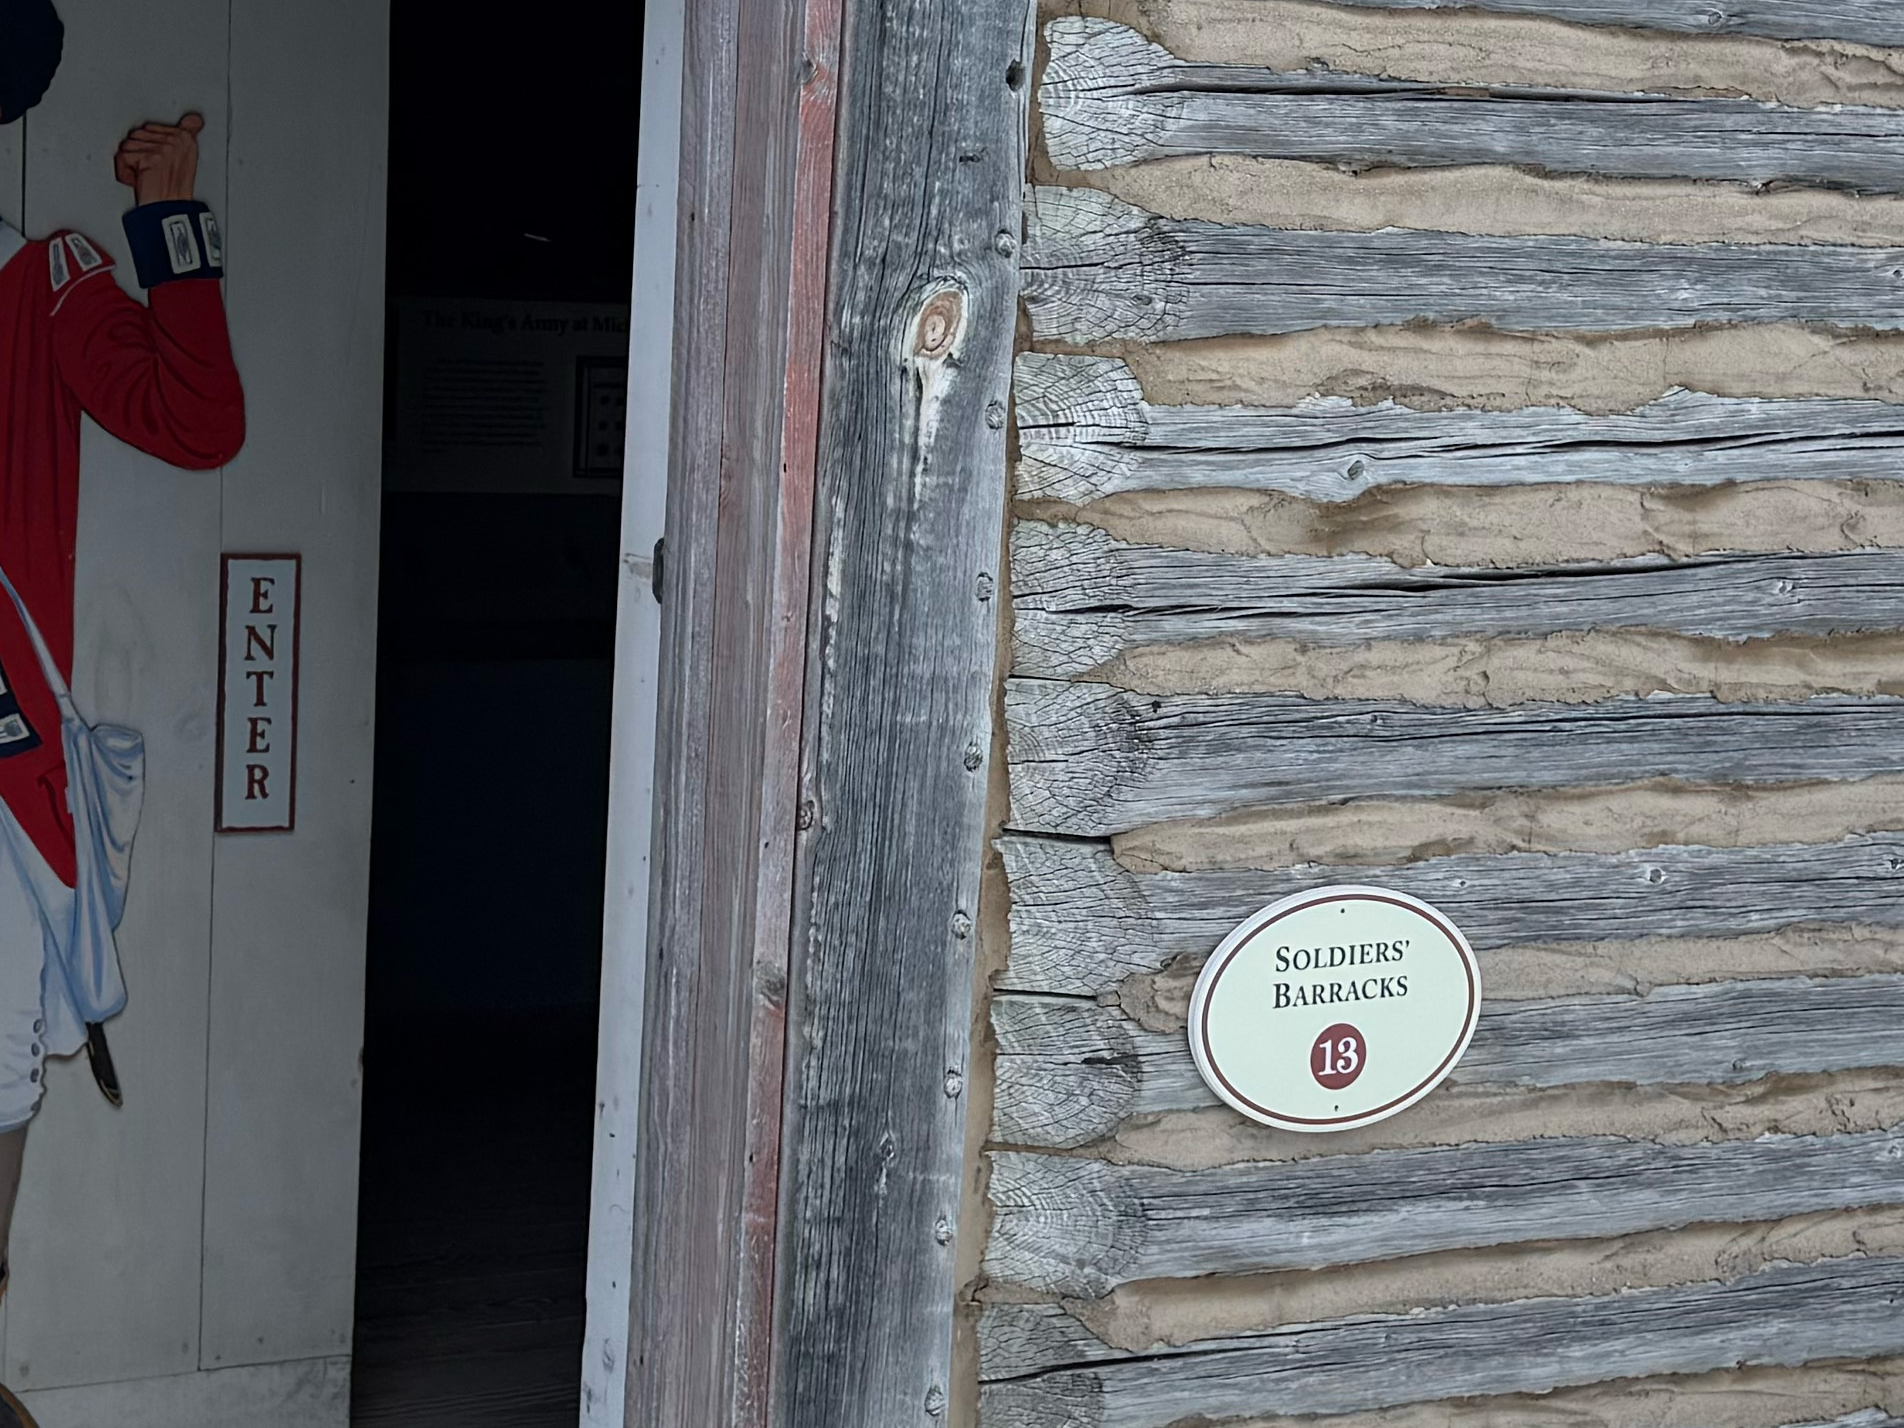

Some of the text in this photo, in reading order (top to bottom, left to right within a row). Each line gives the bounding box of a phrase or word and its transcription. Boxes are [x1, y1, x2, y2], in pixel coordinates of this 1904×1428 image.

[422, 310, 456, 328] The
[461, 310, 516, 335] King's
[522, 314, 568, 336] Army
[244, 577, 277, 800] ENTER
[1276, 940, 1410, 972] SOLDIERS'
[1273, 975, 1408, 1009] BARRACKS
[1318, 1037, 1359, 1076] 13
